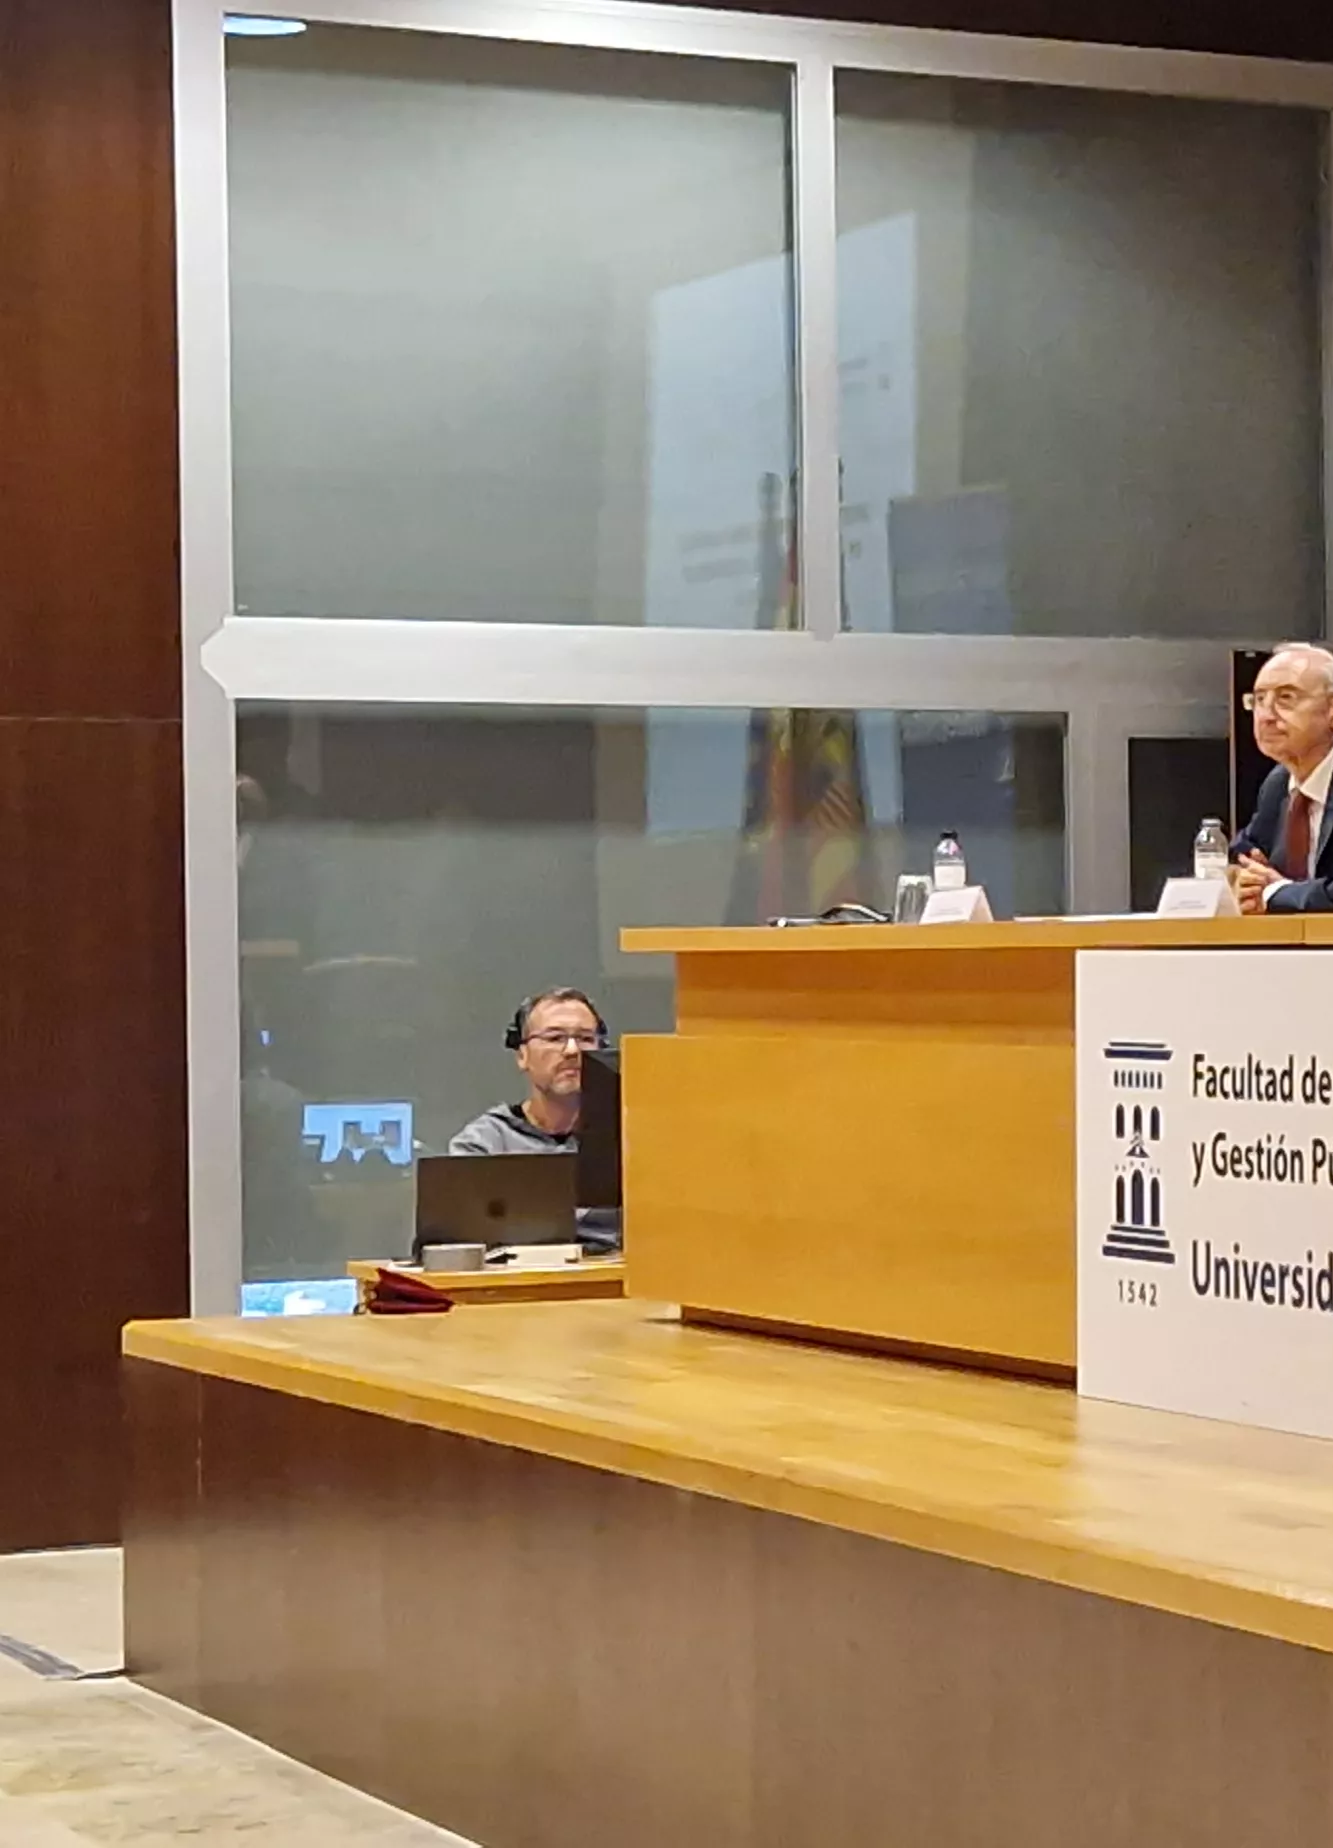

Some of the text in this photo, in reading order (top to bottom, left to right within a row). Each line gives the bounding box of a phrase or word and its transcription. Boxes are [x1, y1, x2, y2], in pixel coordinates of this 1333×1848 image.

[1192, 1052, 1294, 1103] Facultad
[1301, 1055, 1332, 1105] de
[1192, 1140, 1206, 1188] y
[1211, 1132, 1304, 1184] Gestión
[1117, 1278, 1158, 1308] 1542
